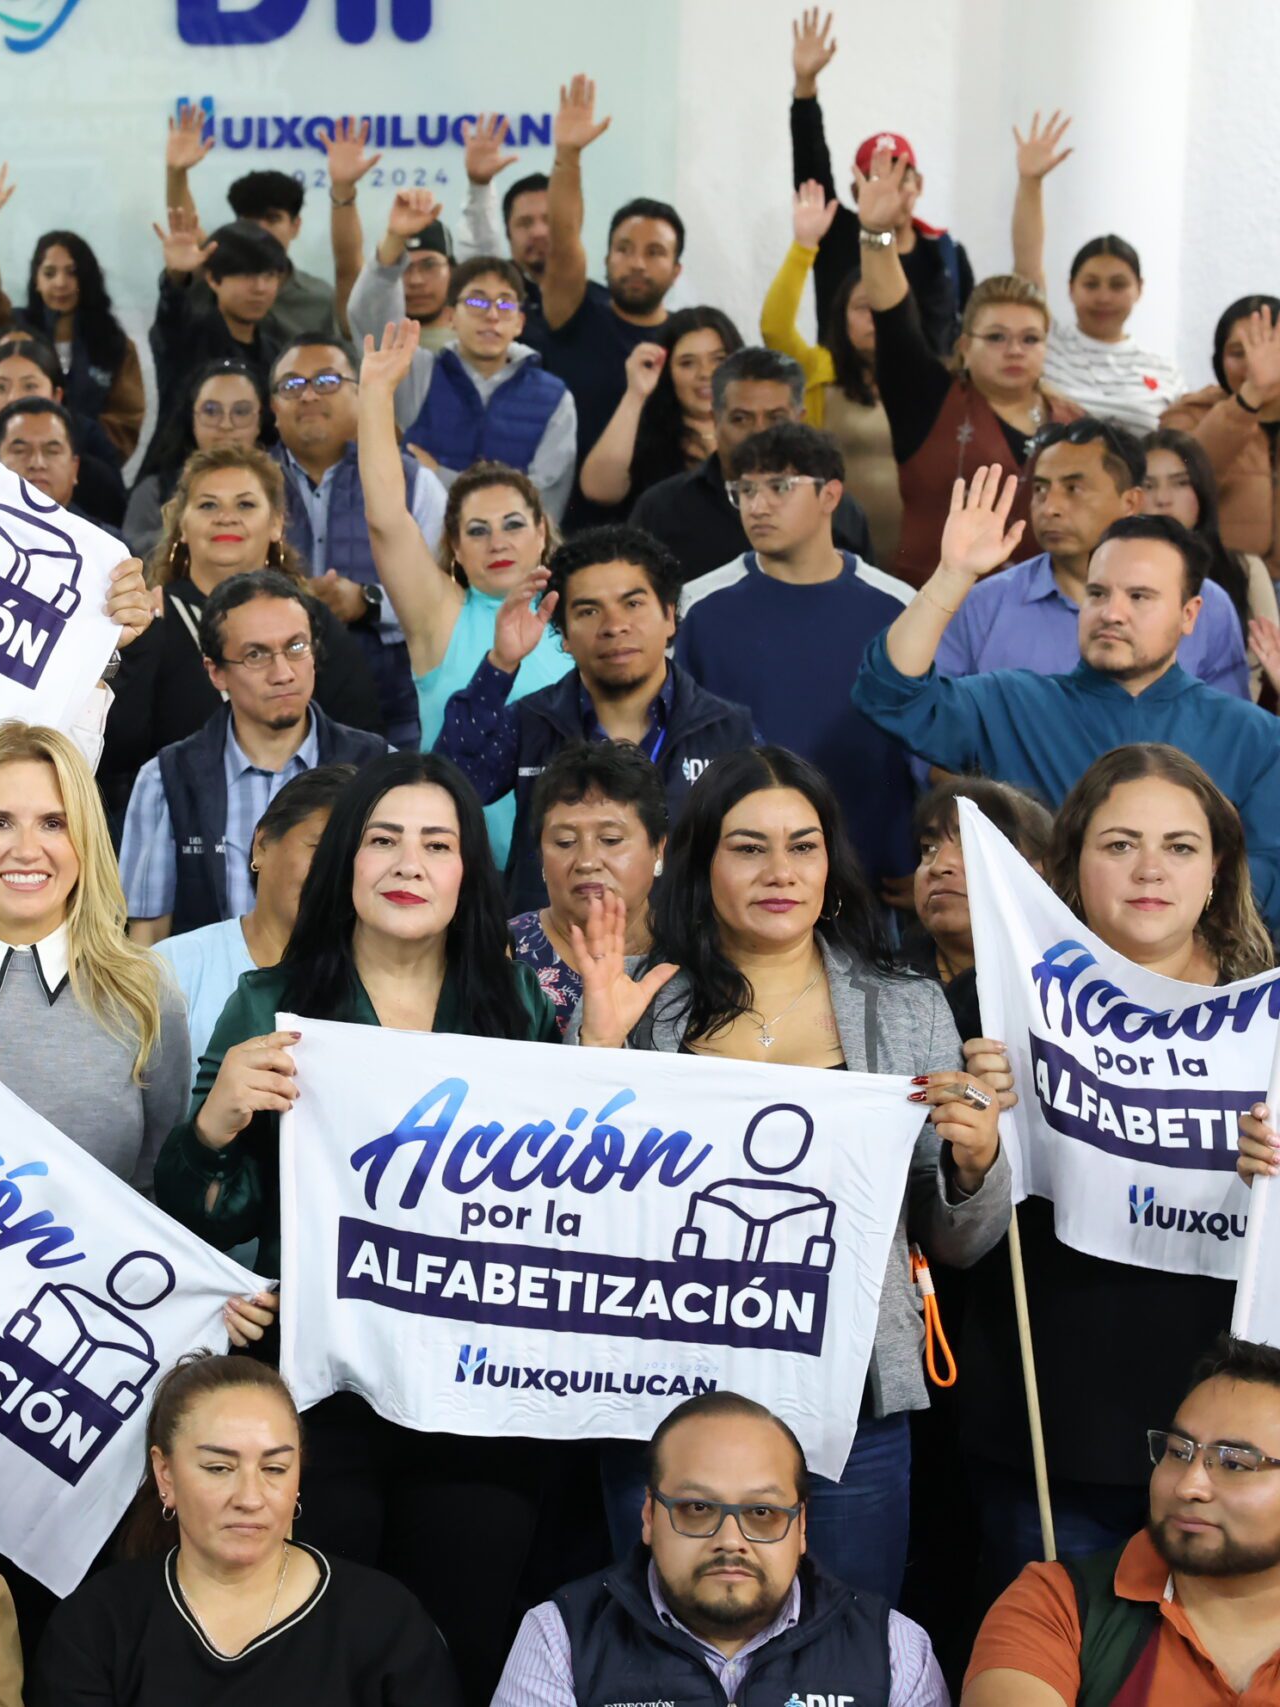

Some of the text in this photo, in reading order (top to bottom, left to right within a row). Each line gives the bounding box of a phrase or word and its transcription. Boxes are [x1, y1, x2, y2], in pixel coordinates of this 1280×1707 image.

[372, 167, 449, 187] 2024
[1093, 1045, 1209, 1077] por la
[1036, 1058, 1251, 1152] ALFABETI
[349, 1077, 713, 1211] Acción
[460, 1201, 582, 1237] por la
[1129, 1184, 1248, 1241] HUIXQU
[346, 1240, 817, 1334] ALFABETIZACIÓN
[455, 1344, 718, 1397] HUIXQUILUCAN
